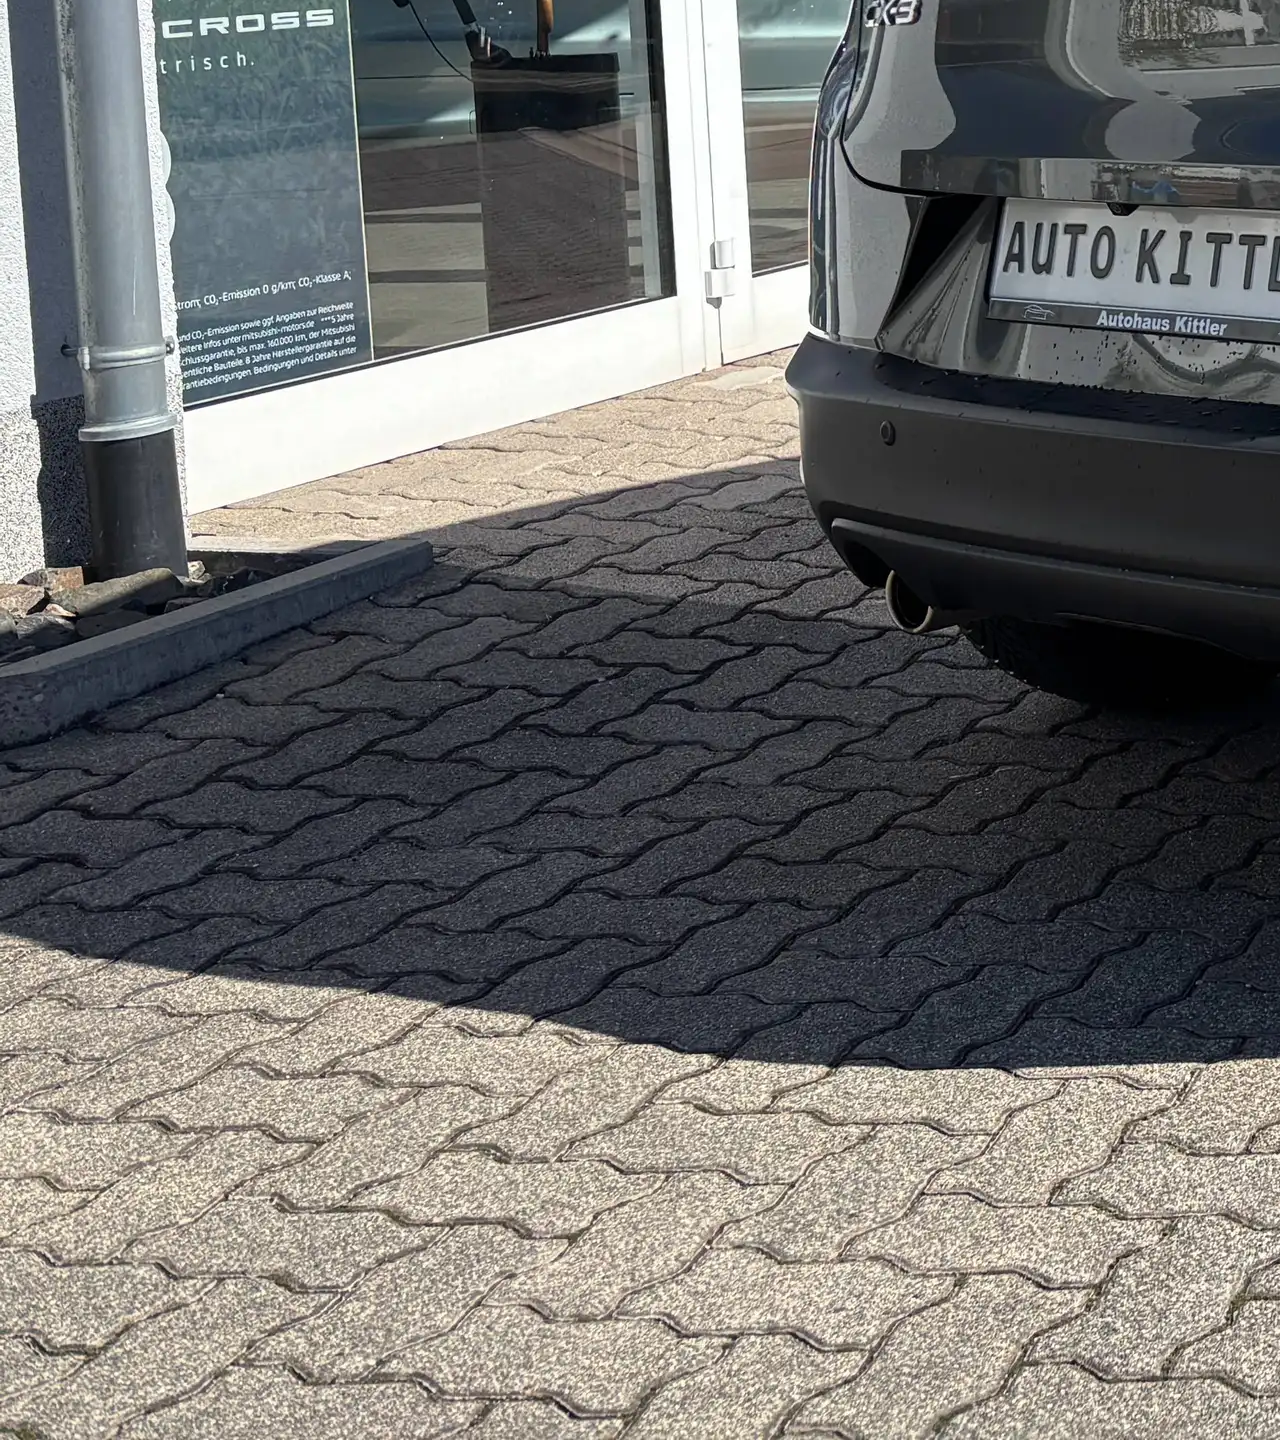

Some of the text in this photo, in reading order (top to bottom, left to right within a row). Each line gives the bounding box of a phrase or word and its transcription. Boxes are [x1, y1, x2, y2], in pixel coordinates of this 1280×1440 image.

[161, 8, 335, 39] CROSS
[1002, 221, 1117, 279] AUTO
[1096, 309, 1228, 337] Autohaus Kittler
